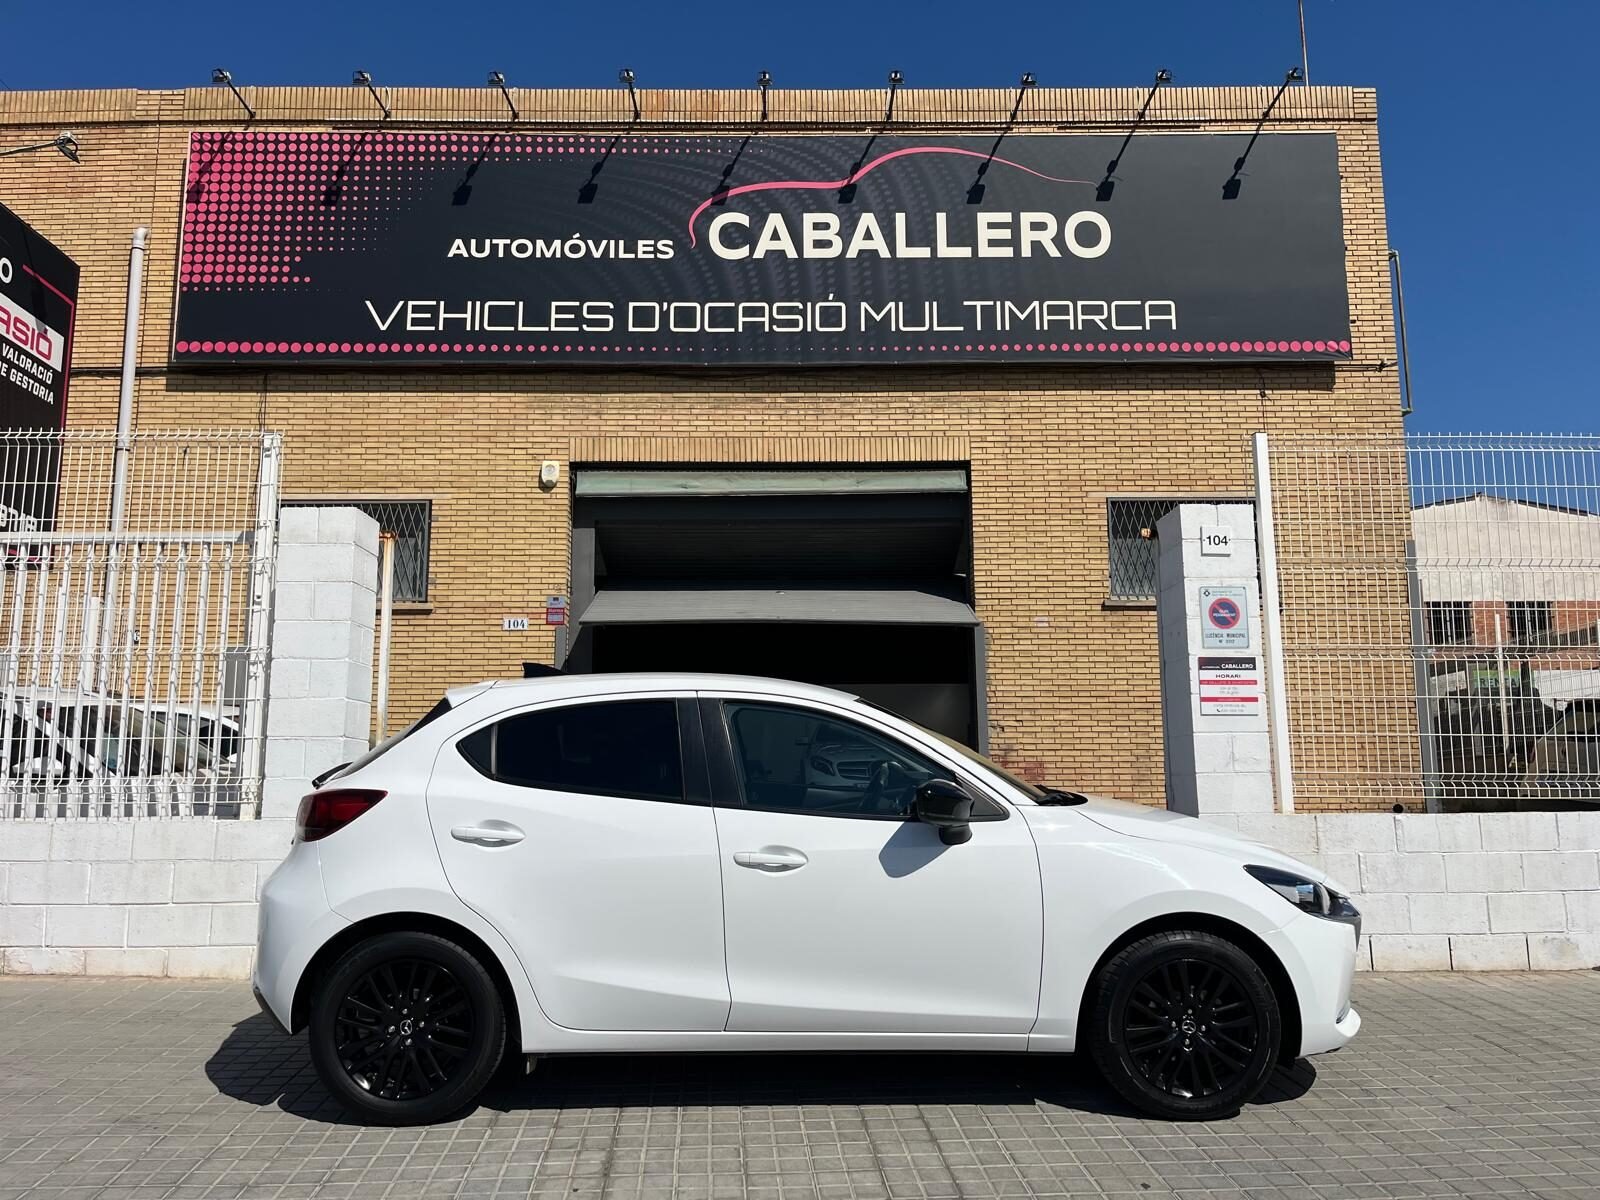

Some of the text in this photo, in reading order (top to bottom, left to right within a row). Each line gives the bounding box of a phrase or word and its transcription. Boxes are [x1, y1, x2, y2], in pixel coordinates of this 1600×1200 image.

[447, 210, 1112, 260] AUTOMÓVILES CABALLERO
[365, 294, 1177, 333] VEHICLES D'OCASIÓ MULTIMARCA
[2, 342, 53, 385] VALORACIÓ
[9, 368, 54, 405] GESTORIA
[1206, 534, 1229, 546] 104
[508, 619, 525, 629] 104
